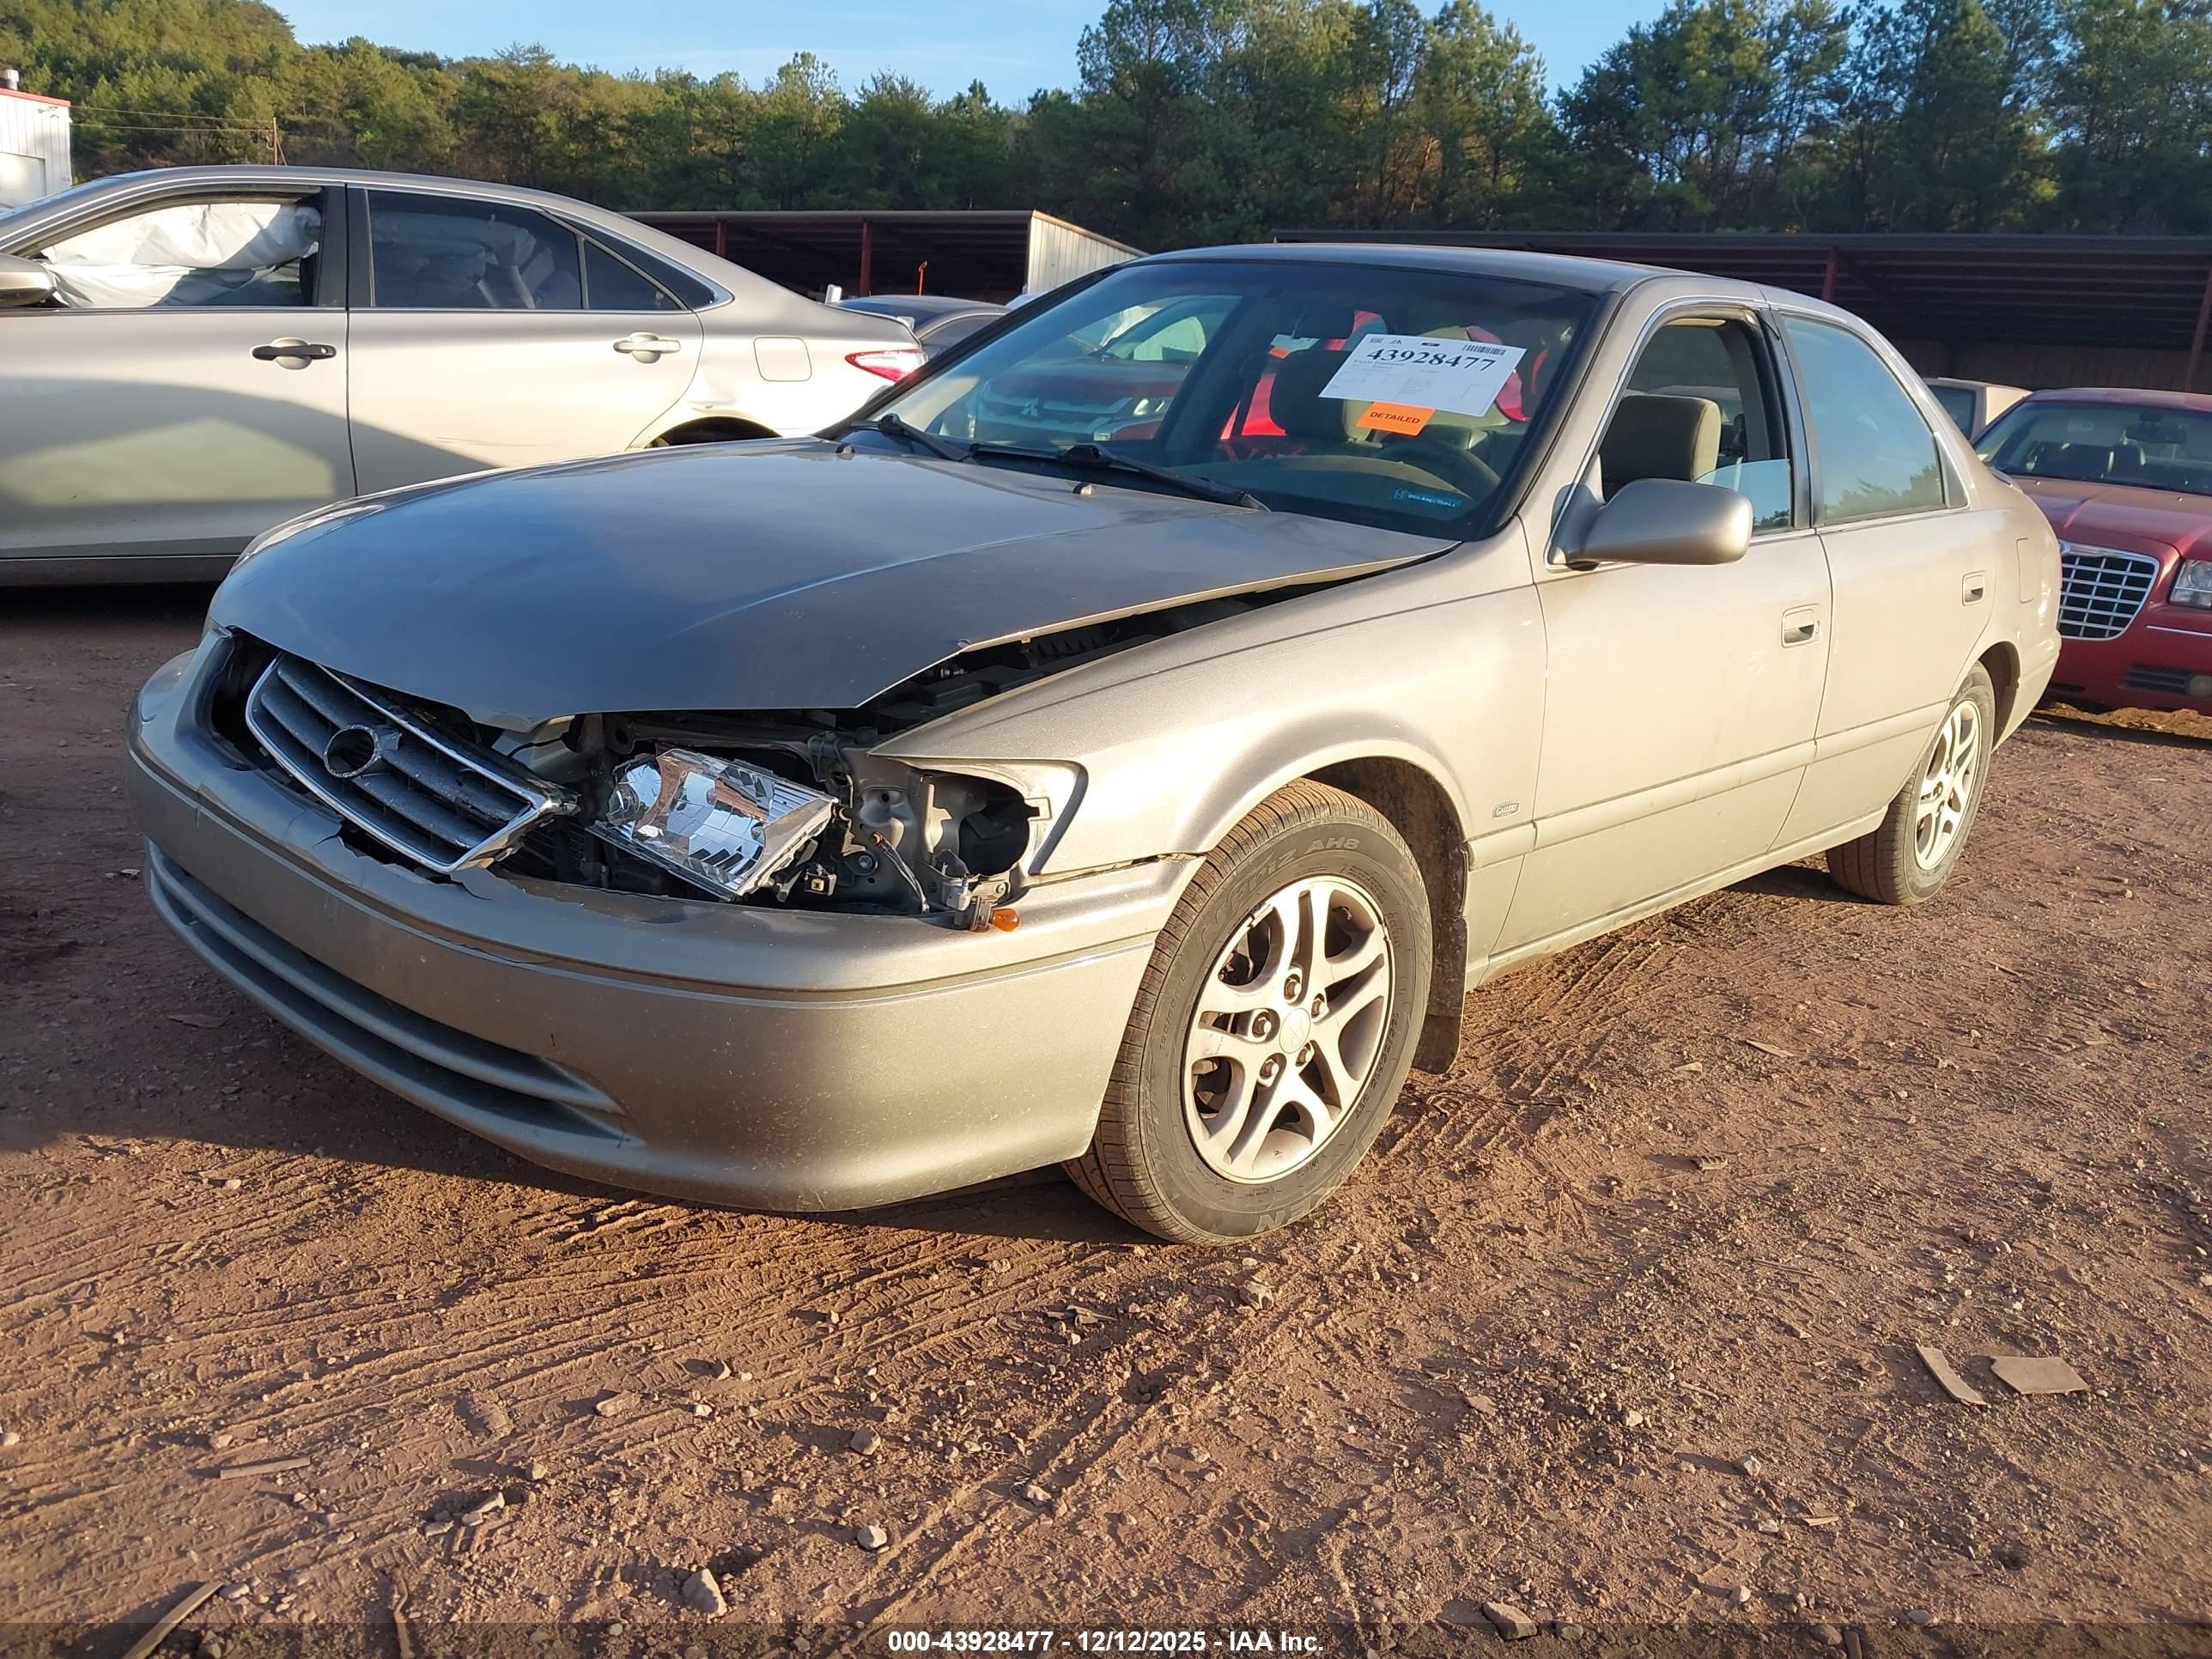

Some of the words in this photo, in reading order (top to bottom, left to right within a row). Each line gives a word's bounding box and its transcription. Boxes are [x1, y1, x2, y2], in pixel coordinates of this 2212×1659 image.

[1367, 348, 1497, 372] 43928477
[1370, 411, 1420, 424] DETAILED
[1304, 836, 1360, 854] AH8
